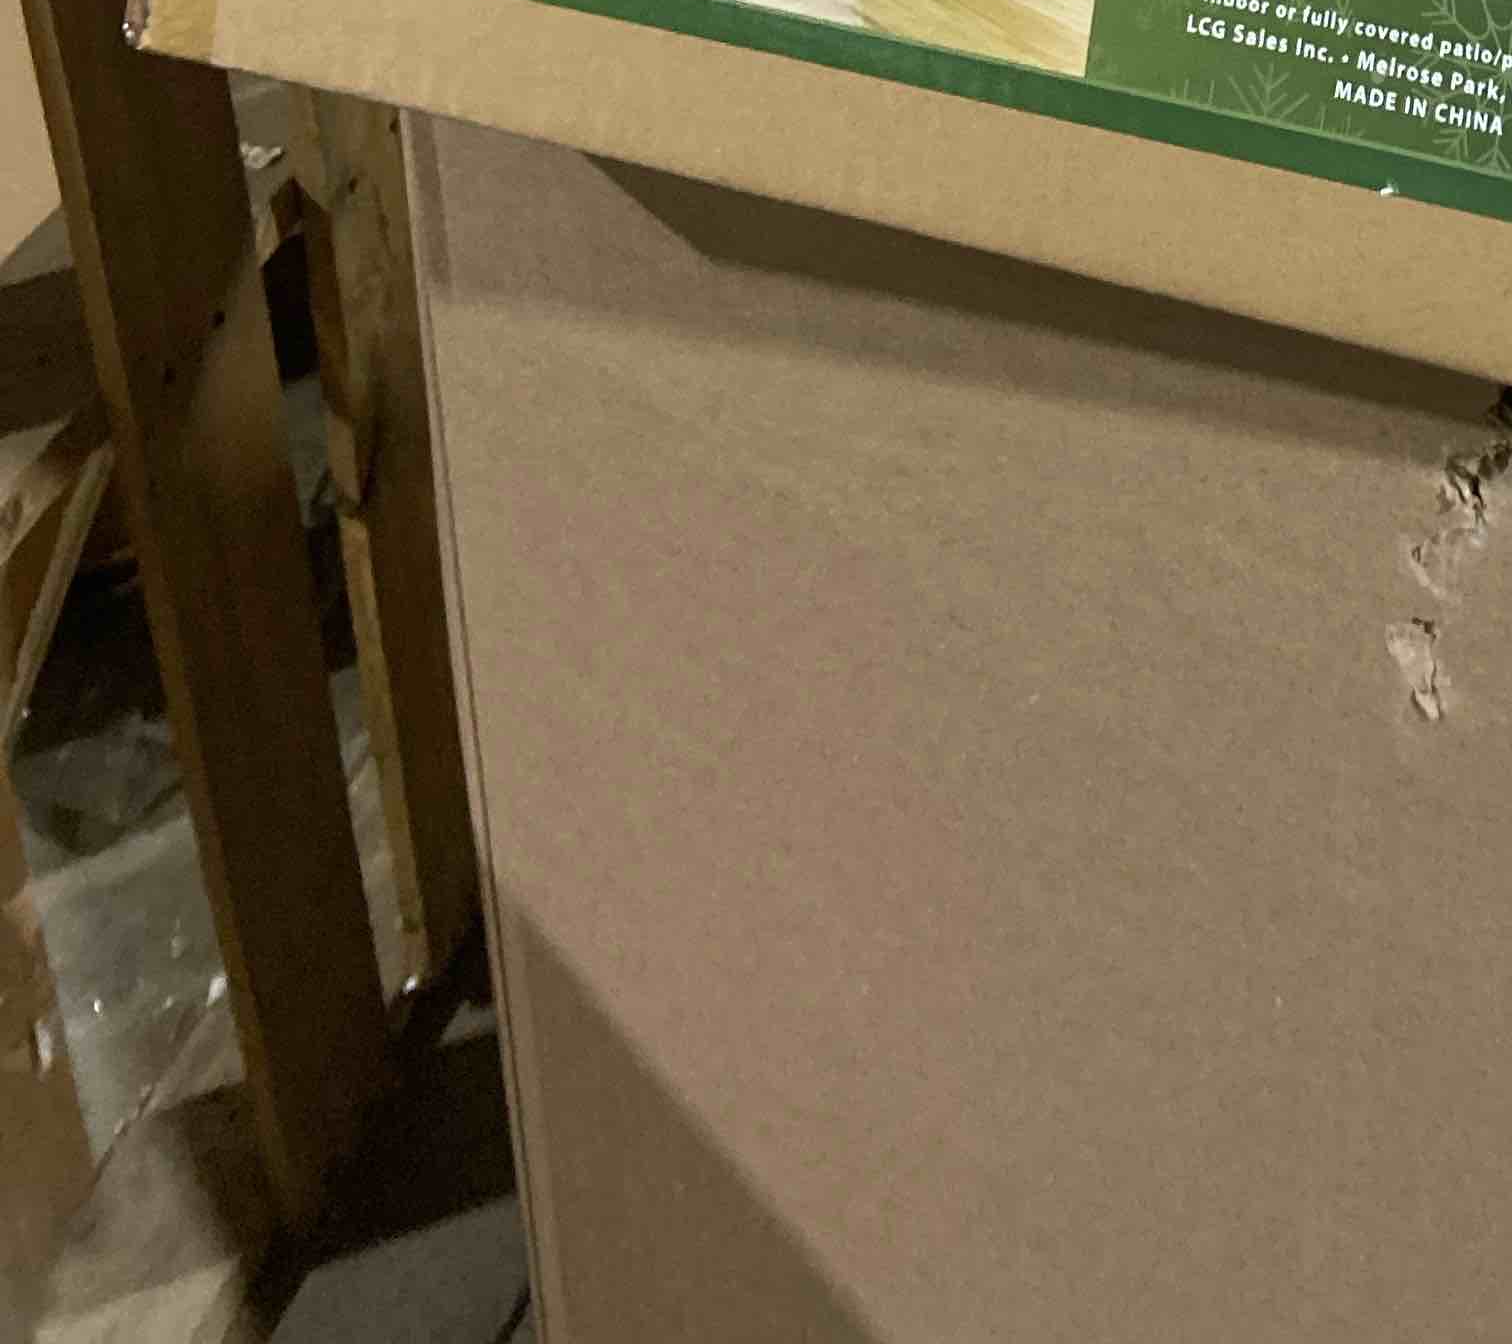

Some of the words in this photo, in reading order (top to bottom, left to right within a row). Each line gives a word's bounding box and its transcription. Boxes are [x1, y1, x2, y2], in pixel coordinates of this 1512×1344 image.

[1276, 5, 1296, 20] or
[1303, 5, 1348, 35] fully
[1355, 22, 1433, 50] covered
[1187, 14, 1225, 39] LCG
[1233, 24, 1287, 52] Sales
[1296, 38, 1333, 63] Inc.
[1357, 49, 1442, 88] Melrose
[1451, 72, 1505, 104] Park,
[1334, 80, 1396, 110] MADE
[1405, 96, 1427, 117] IN
[1435, 104, 1502, 136] CHINA
